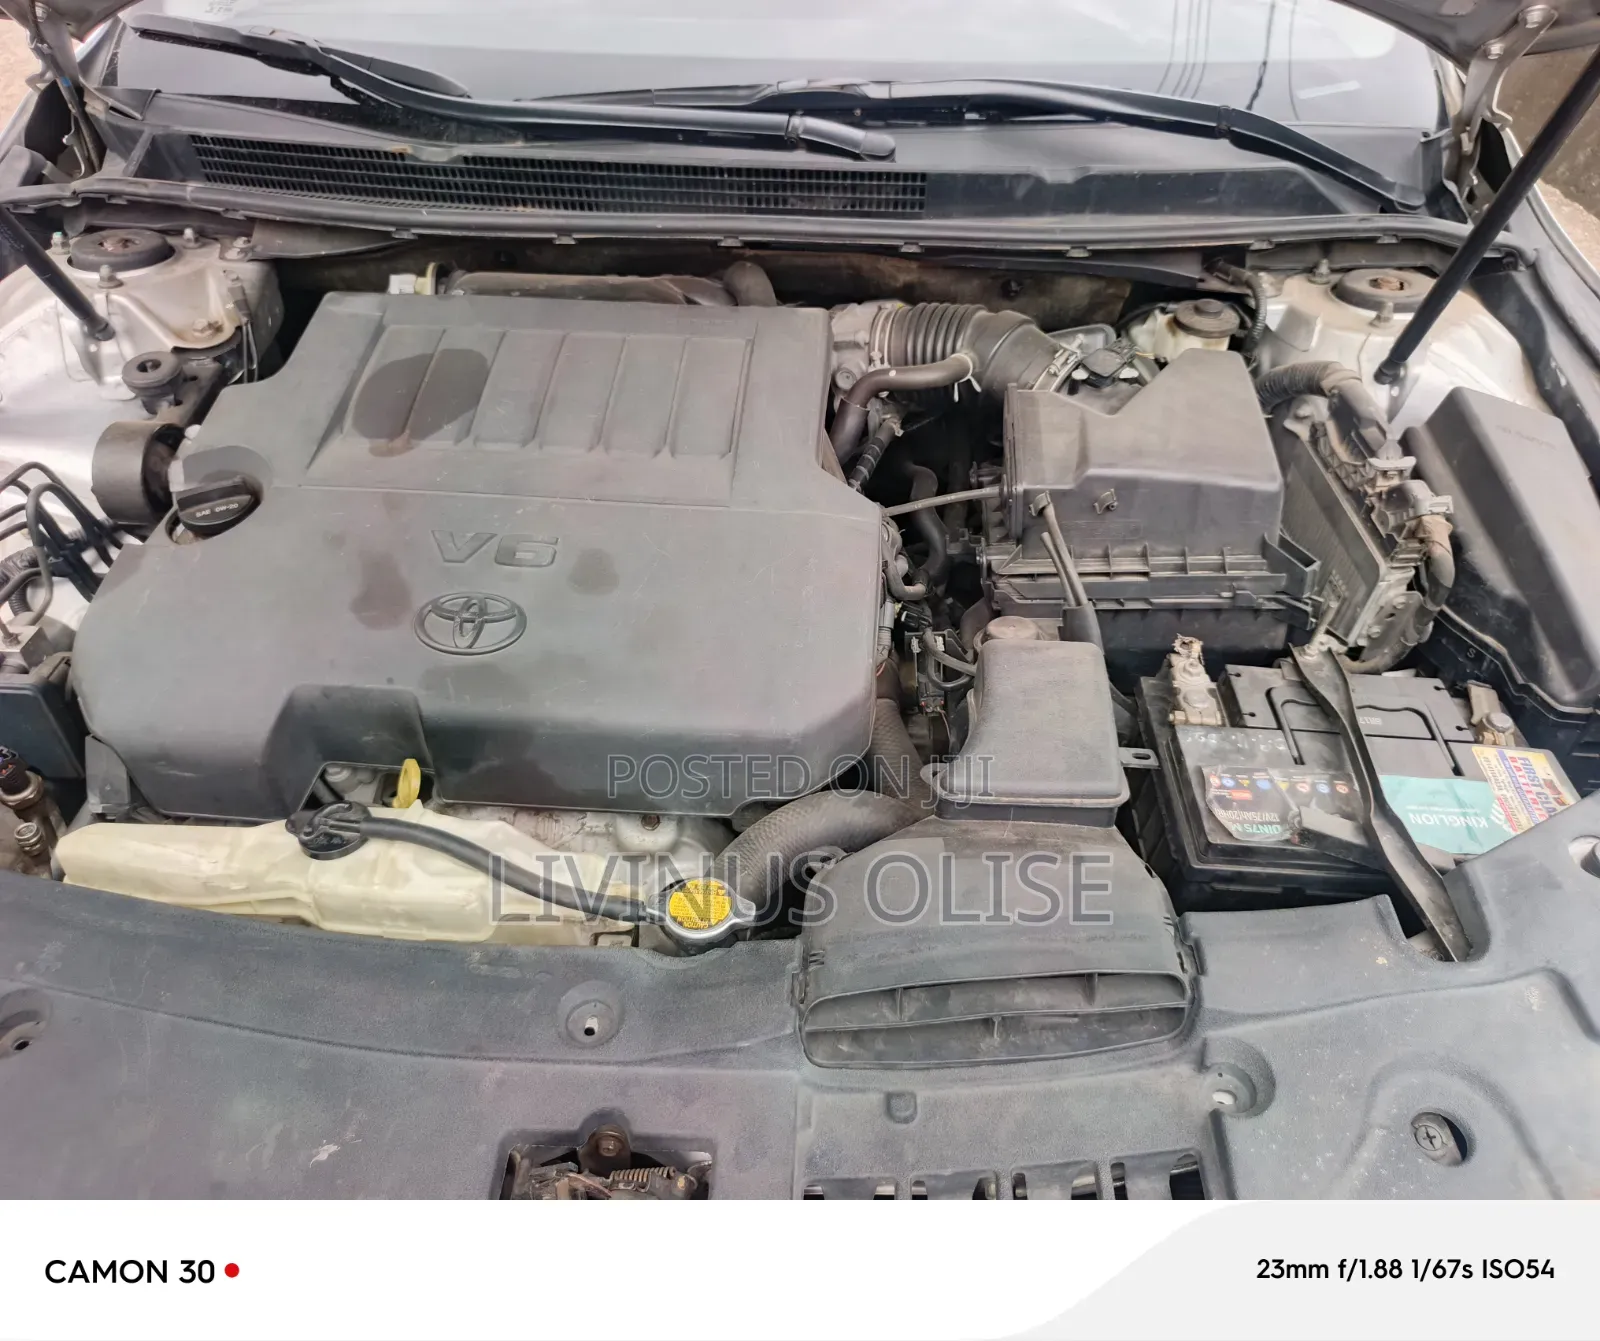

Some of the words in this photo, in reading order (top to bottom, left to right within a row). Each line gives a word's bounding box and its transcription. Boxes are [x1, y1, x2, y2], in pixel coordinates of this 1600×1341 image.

[195, 509, 211, 518] SAE
[430, 529, 560, 568] V6
[1517, 756, 1545, 790] FIRST
[1410, 813, 1489, 828] KINGLION
[1245, 823, 1281, 835] DIN75
[682, 921, 709, 929] CAUTION
